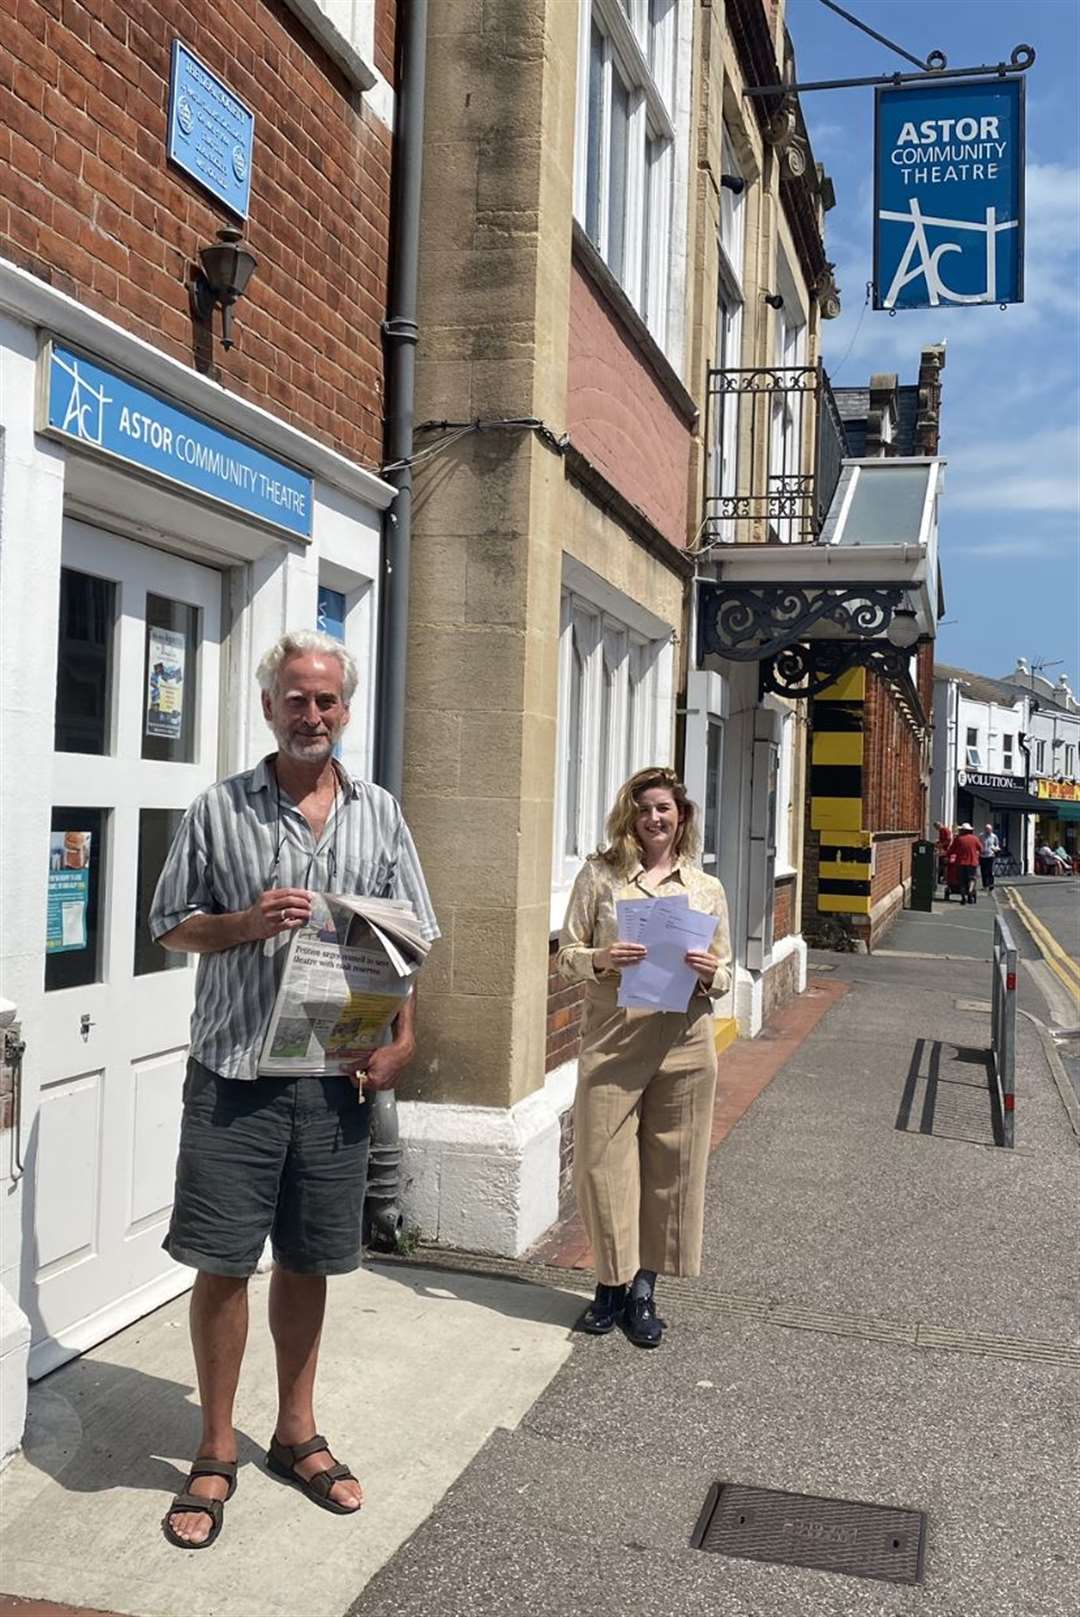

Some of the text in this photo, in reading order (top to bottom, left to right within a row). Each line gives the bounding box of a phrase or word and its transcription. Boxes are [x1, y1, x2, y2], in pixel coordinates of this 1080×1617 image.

[897, 116, 999, 145] ASTOR
[891, 142, 1007, 165] COMMUNITY
[901, 163, 1000, 184] THEATRE
[119, 406, 306, 517] ASTOR COMMUNITY THEATRE
[958, 771, 1013, 788] EVOLUTION
